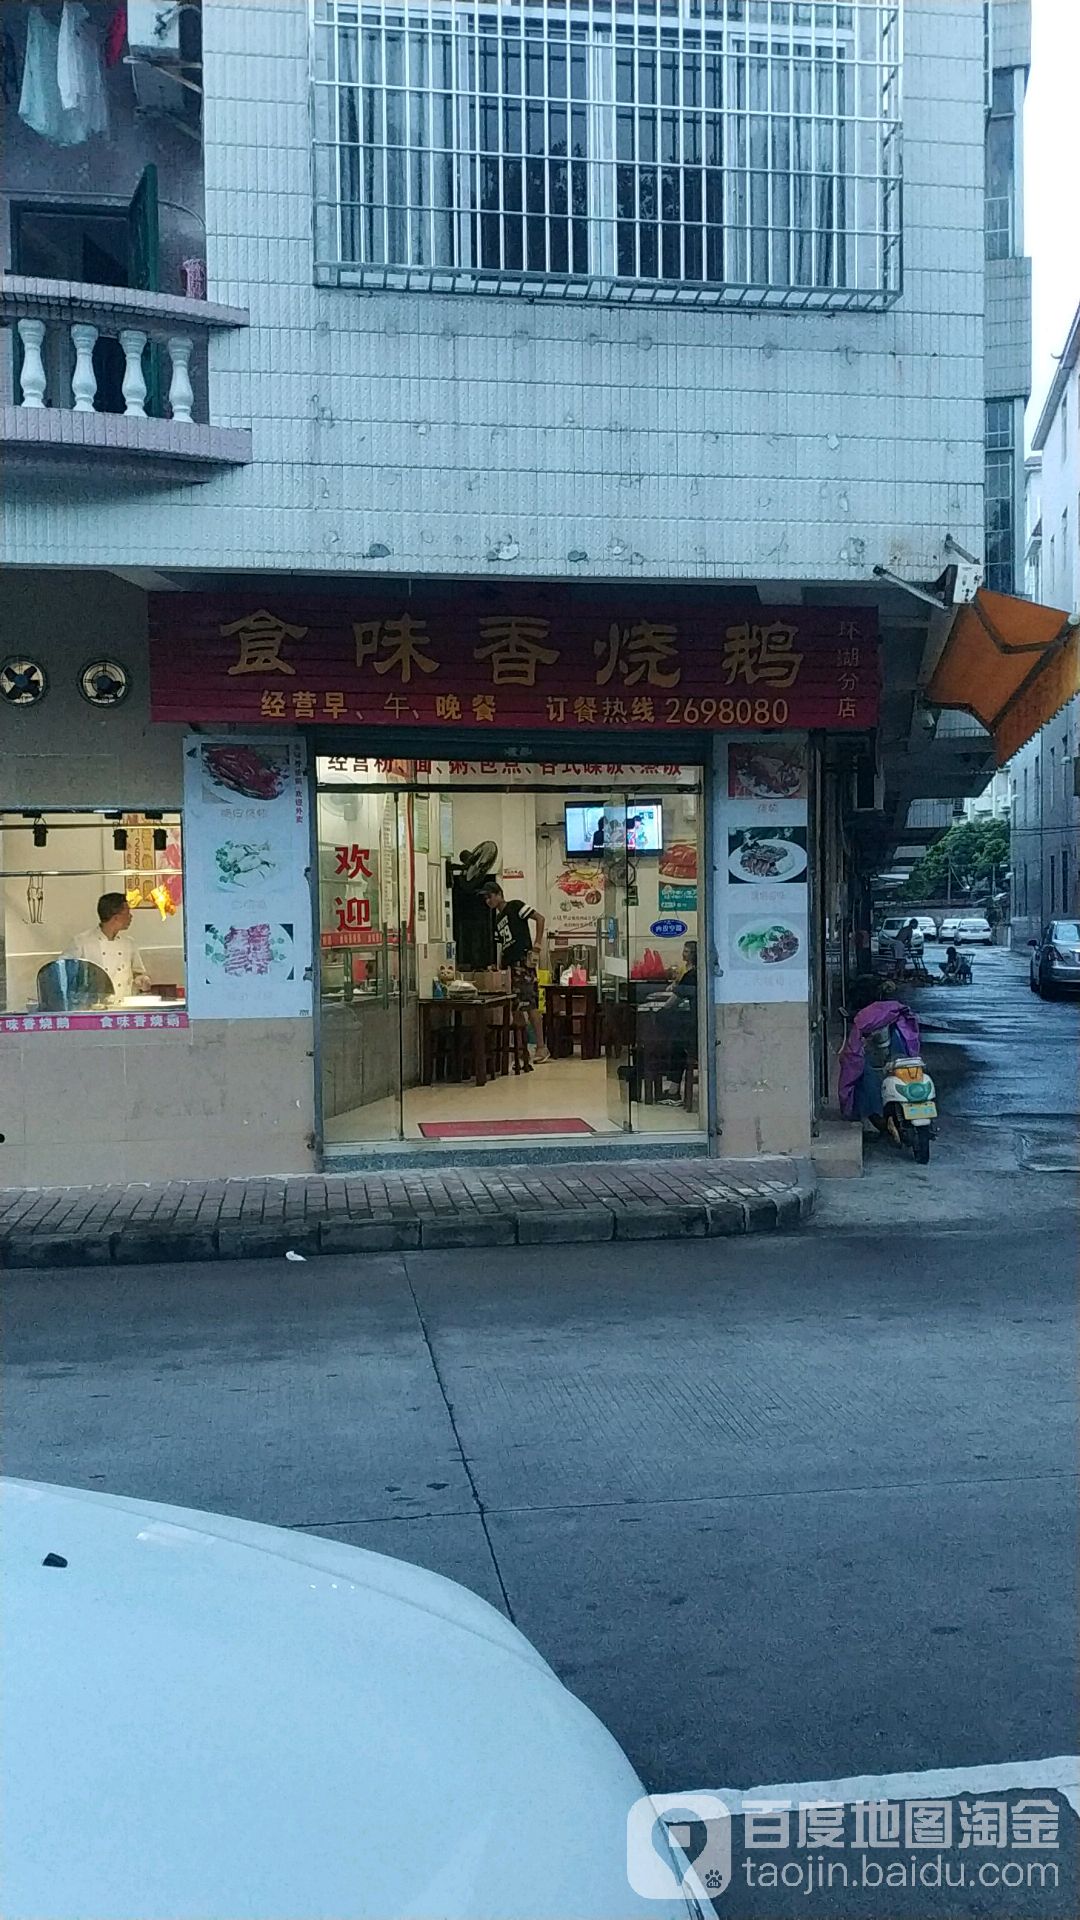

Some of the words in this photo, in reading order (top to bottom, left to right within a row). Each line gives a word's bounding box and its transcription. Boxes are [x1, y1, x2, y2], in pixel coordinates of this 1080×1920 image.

[219, 608, 804, 689] 食味香烧鹅
[334, 843, 373, 932] 欢迎
